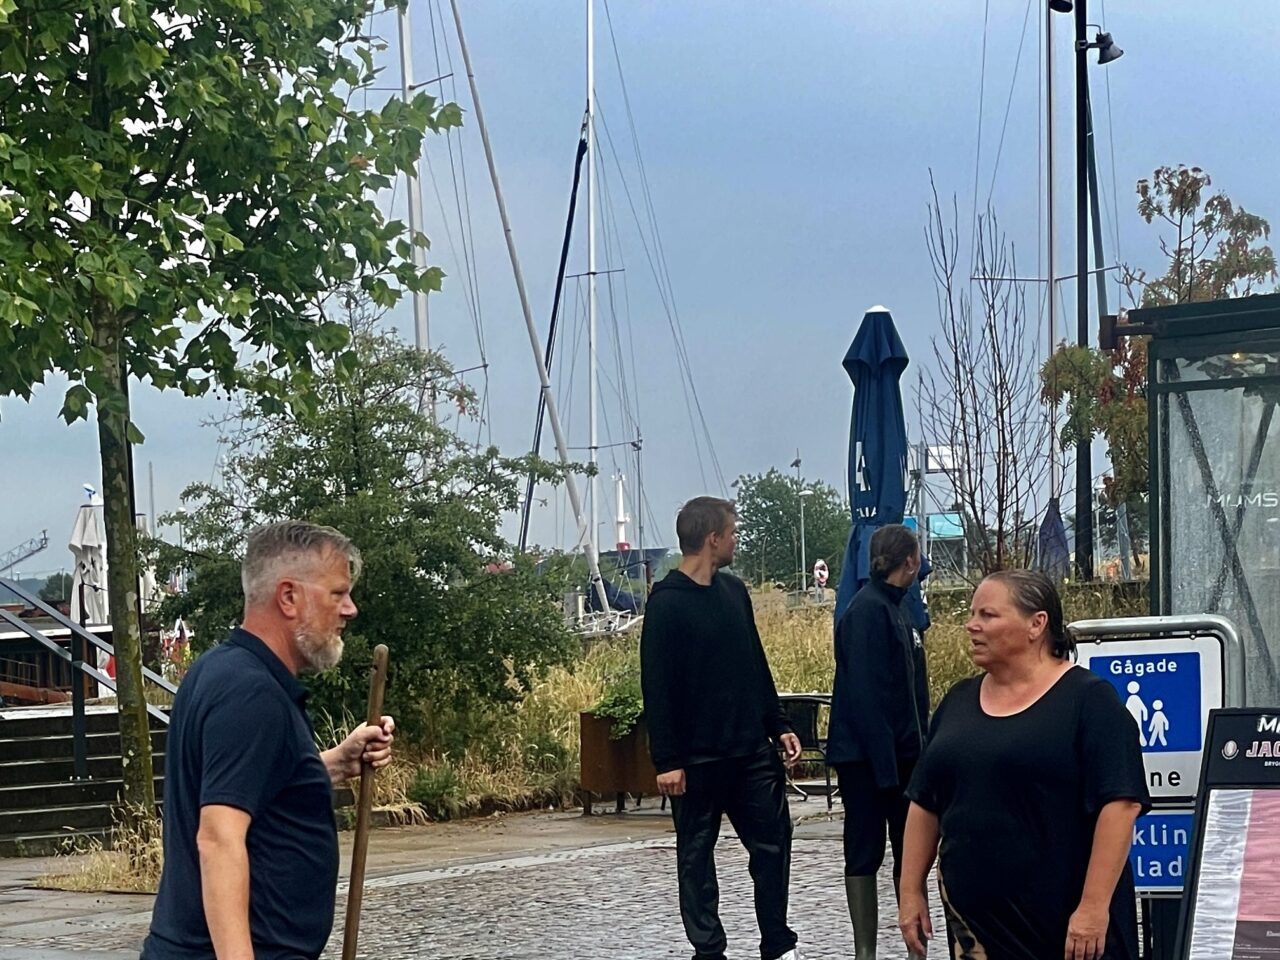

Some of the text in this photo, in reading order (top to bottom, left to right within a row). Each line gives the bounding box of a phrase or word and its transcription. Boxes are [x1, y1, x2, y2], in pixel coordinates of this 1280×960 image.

[1110, 658, 1178, 677] Gågade
[1149, 770, 1182, 787] ne
[1132, 823, 1188, 846] klin
